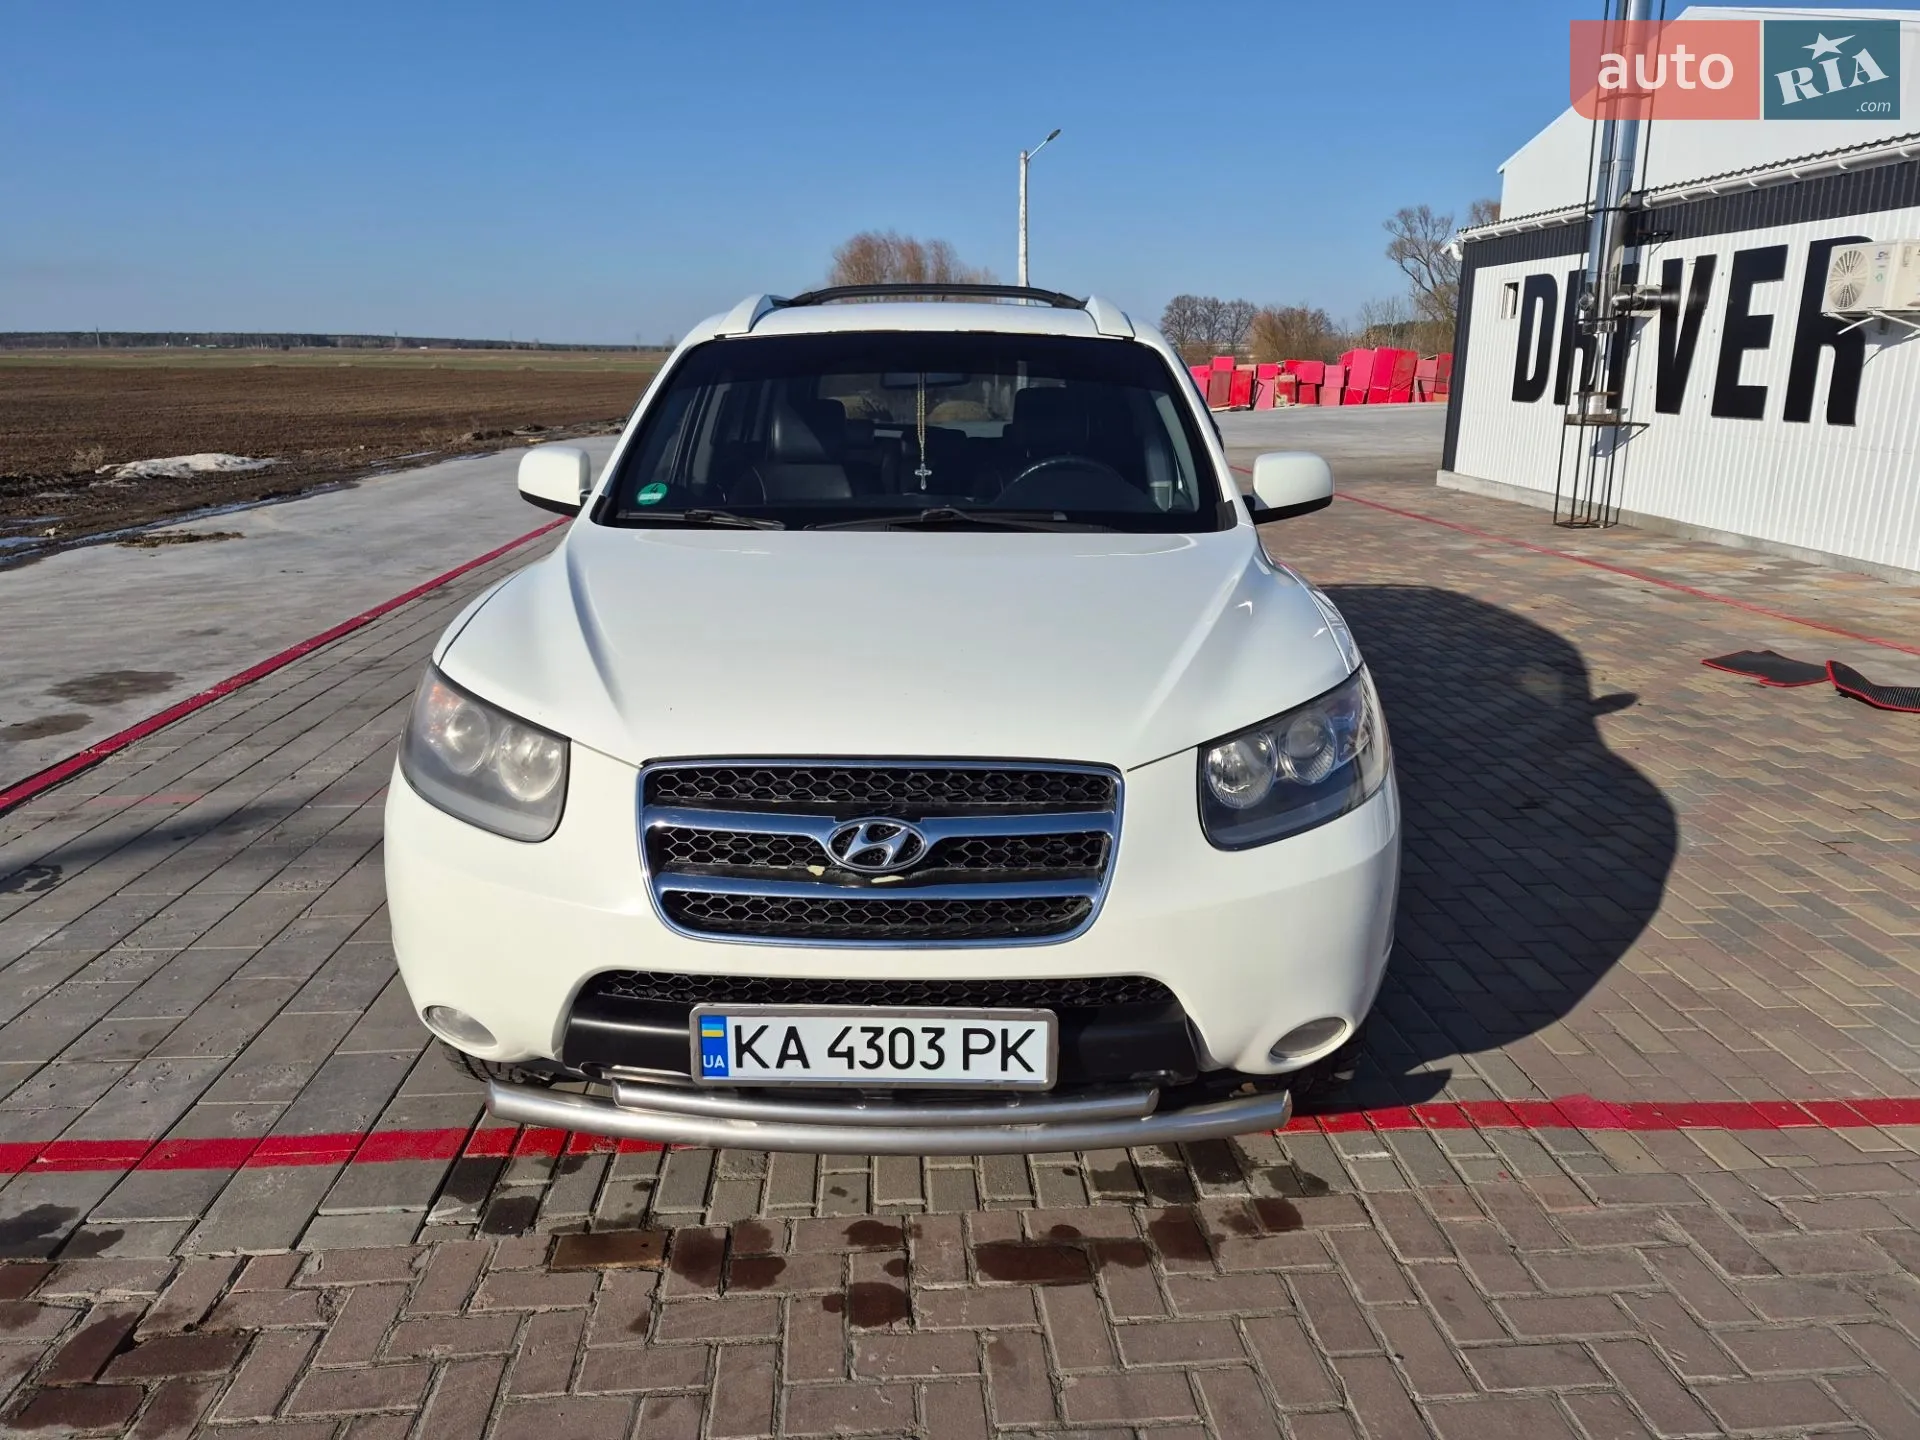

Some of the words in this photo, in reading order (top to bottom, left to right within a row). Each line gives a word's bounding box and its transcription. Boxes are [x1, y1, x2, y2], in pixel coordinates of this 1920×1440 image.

[702, 1054, 725, 1069] UA
[733, 1024, 811, 1069] KA
[827, 1026, 946, 1070] 4303
[962, 1027, 1036, 1073] PK
